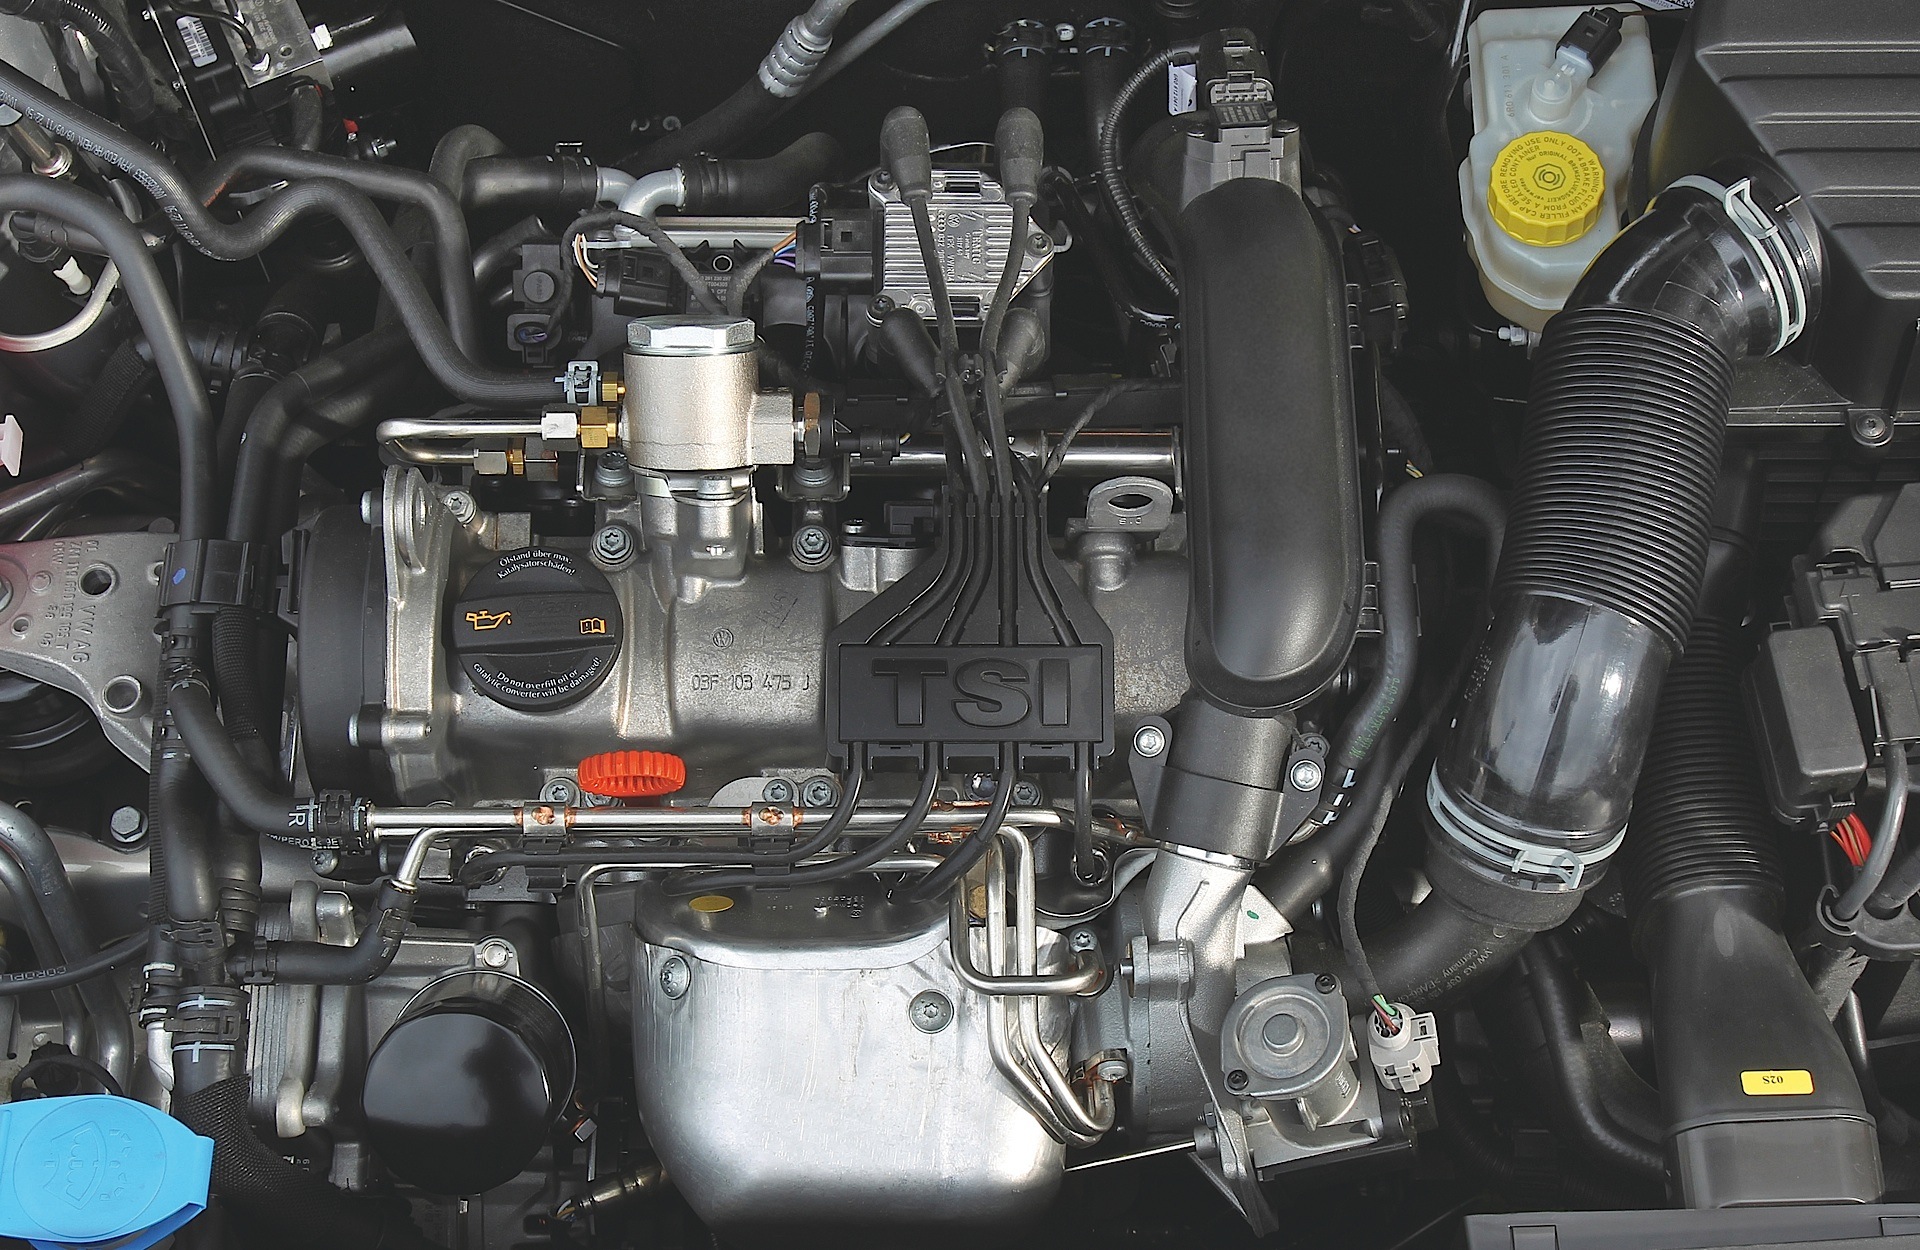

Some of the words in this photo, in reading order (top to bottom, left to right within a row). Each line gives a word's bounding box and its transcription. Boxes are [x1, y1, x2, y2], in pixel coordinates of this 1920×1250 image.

[1524, 137, 1542, 147] USE
[1543, 136, 1566, 147] ONLY
[1500, 144, 1524, 177] REMOVING
[1509, 145, 1540, 177] CONTAINER
[1539, 150, 1567, 161] ORIGINAL
[1580, 162, 1590, 187] BRAKE
[1588, 159, 1600, 193] WARNING
[1500, 180, 1520, 206] BEFORE
[1510, 179, 1533, 205] SEALED
[1568, 189, 1588, 206] FLUID
[1519, 206, 1537, 217] CAP
[1543, 202, 1567, 211] FROM
[1571, 194, 1595, 214] CLEAN
[1540, 211, 1570, 220] FILLER
[499, 551, 531, 567] Ölstand
[532, 549, 551, 559] über
[497, 559, 576, 579] Katalysatorschäden!
[75, 605, 96, 634] VW
[71, 640, 91, 663] AG
[473, 663, 501, 689] catalytic
[501, 684, 542, 699] converter
[541, 687, 558, 698] will
[558, 684, 570, 694] be
[569, 657, 602, 689] damaged!
[496, 671, 510, 684] Do
[510, 678, 525, 689] not
[525, 677, 558, 690] overfill
[558, 673, 570, 686] oil
[569, 669, 578, 679] or
[728, 674, 753, 691] 103
[762, 673, 791, 691] 475
[802, 674, 810, 691] J
[872, 657, 1071, 728] TSI
[1442, 948, 1479, 978] Germany
[0, 965, 67, 982] COROPL
